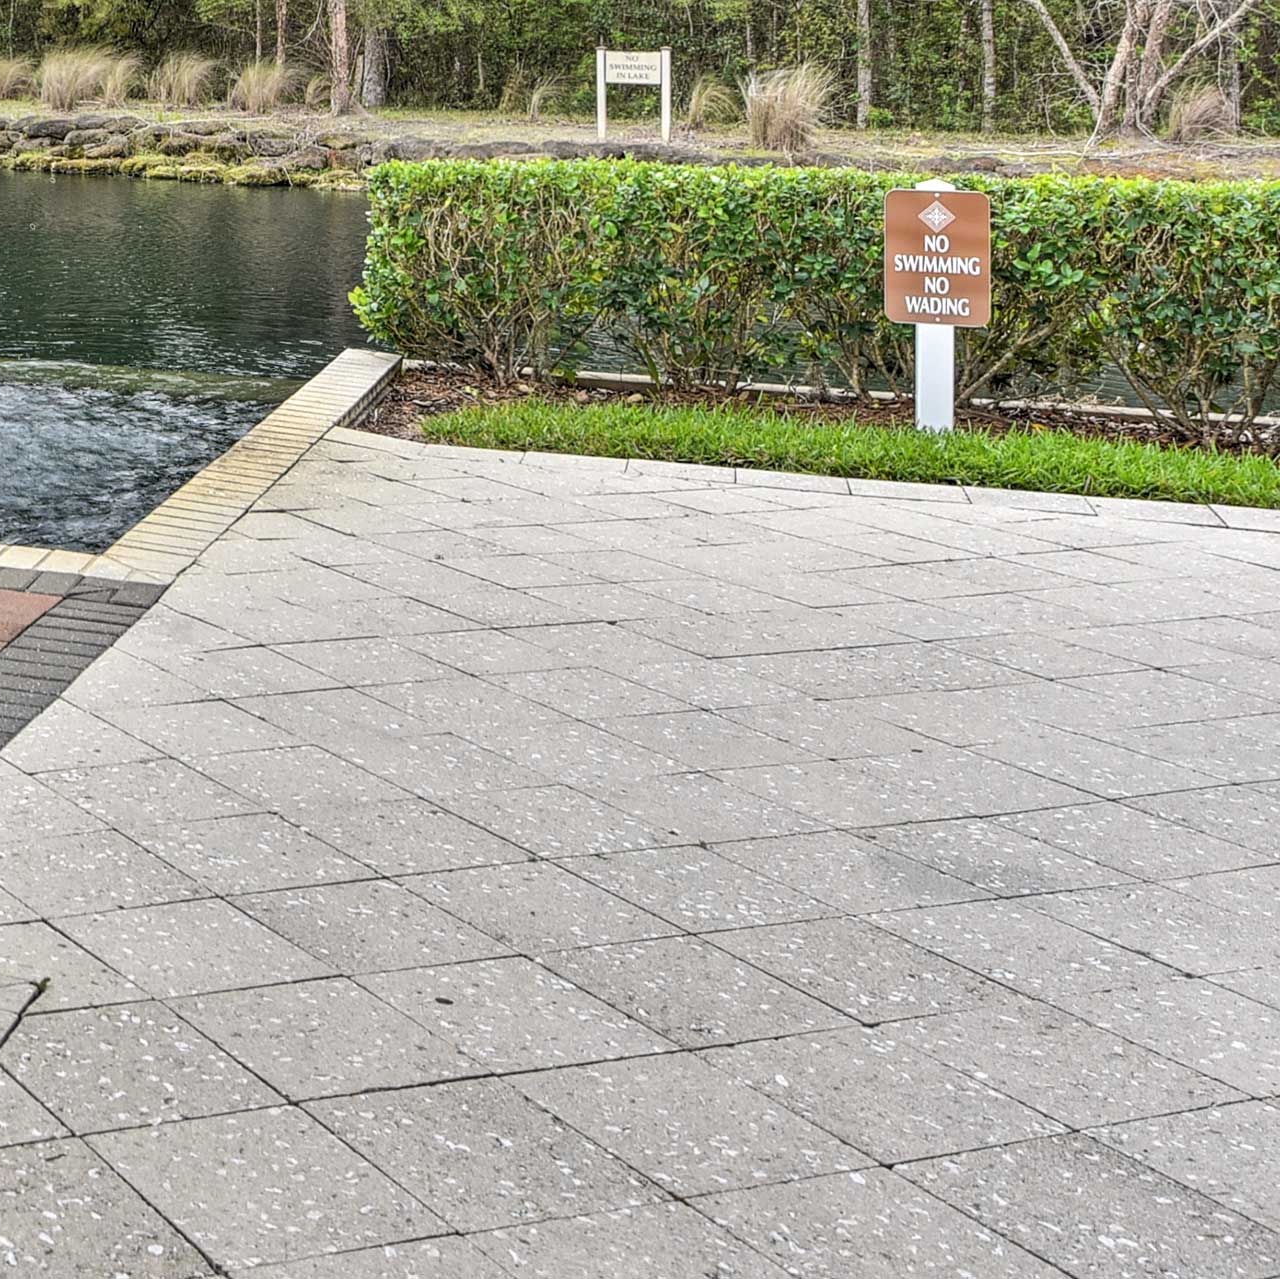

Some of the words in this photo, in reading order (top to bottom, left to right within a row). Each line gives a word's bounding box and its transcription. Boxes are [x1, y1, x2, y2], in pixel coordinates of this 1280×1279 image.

[609, 63, 657, 71] SWIMMING
[924, 235, 949, 253] NO
[894, 254, 980, 276] SWIMMING
[925, 276, 949, 295] NO
[905, 296, 970, 317] WADING
